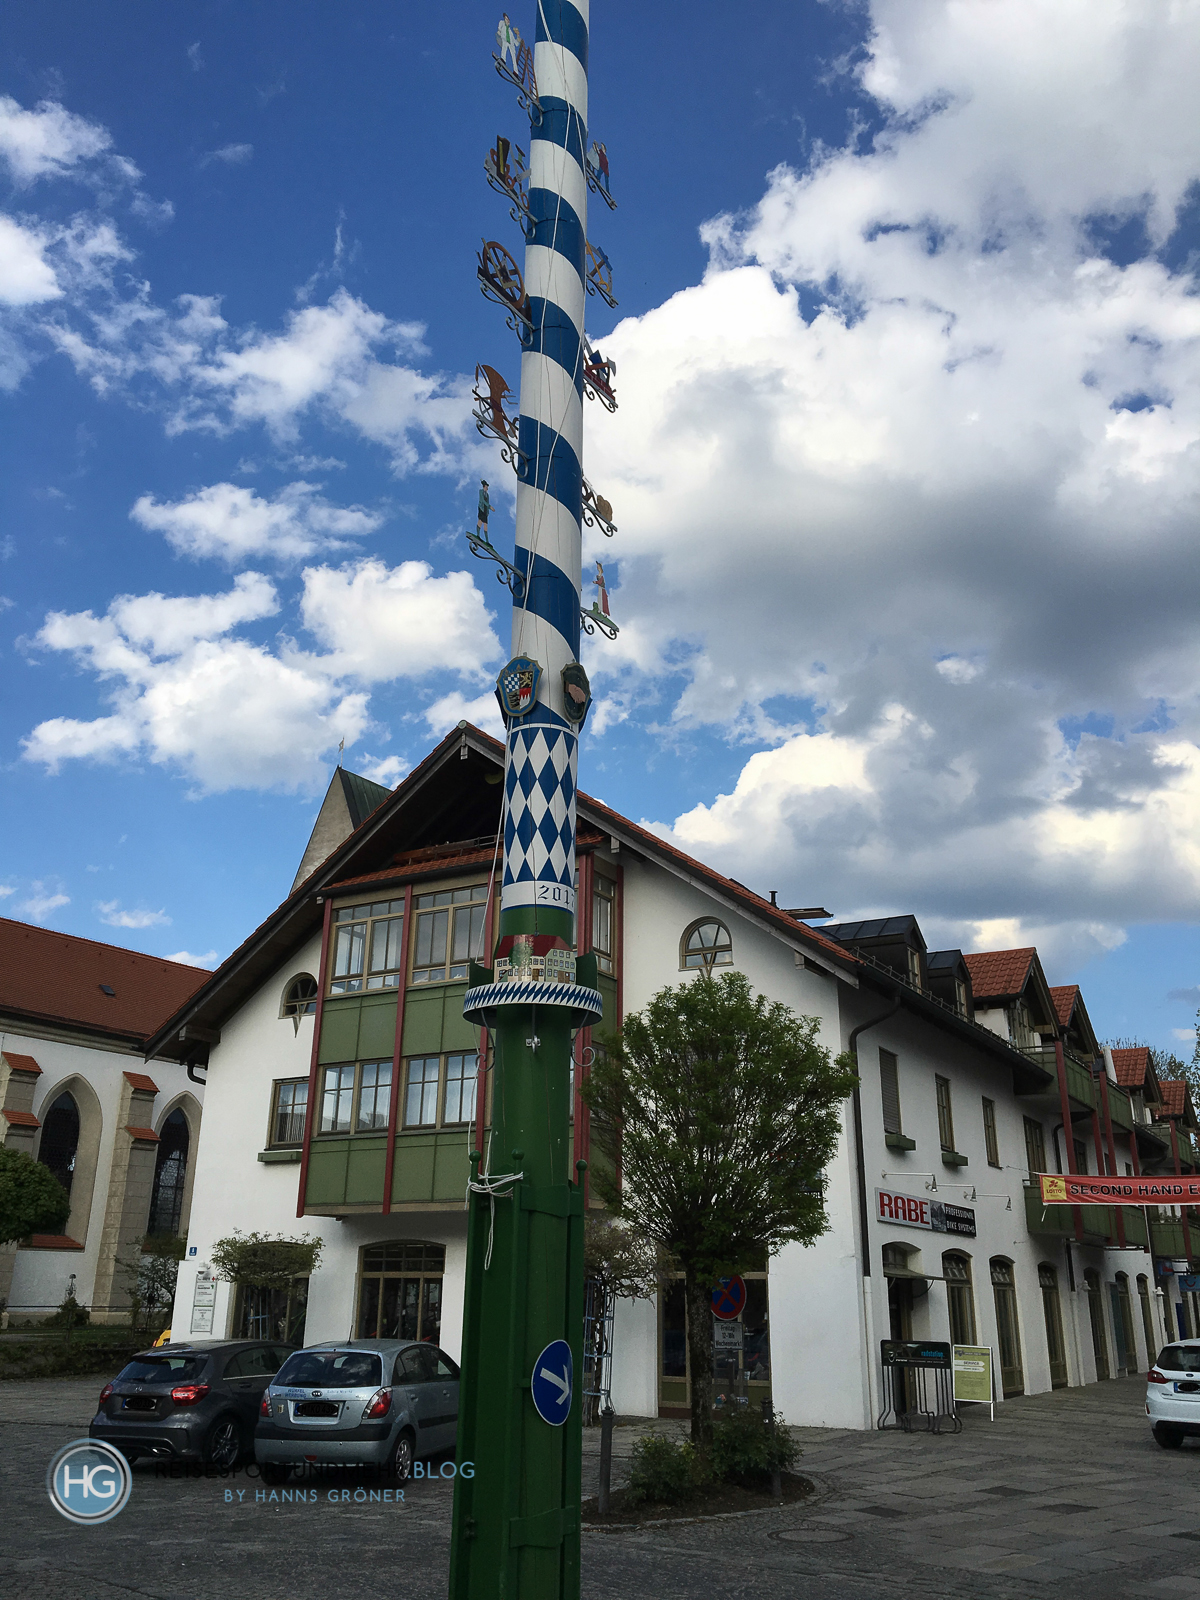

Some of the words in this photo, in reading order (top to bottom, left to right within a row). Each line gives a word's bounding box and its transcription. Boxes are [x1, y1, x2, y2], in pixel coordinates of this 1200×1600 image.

[1070, 1184, 1133, 1195] SECOND
[1138, 1184, 1183, 1196] HAND
[1188, 1183, 1200, 1195] E
[879, 1191, 930, 1225] RABE
[945, 1206, 974, 1219] PROFESSIONAL
[946, 1220, 957, 1230] BIKE
[957, 1222, 976, 1234] SYSTEMS
